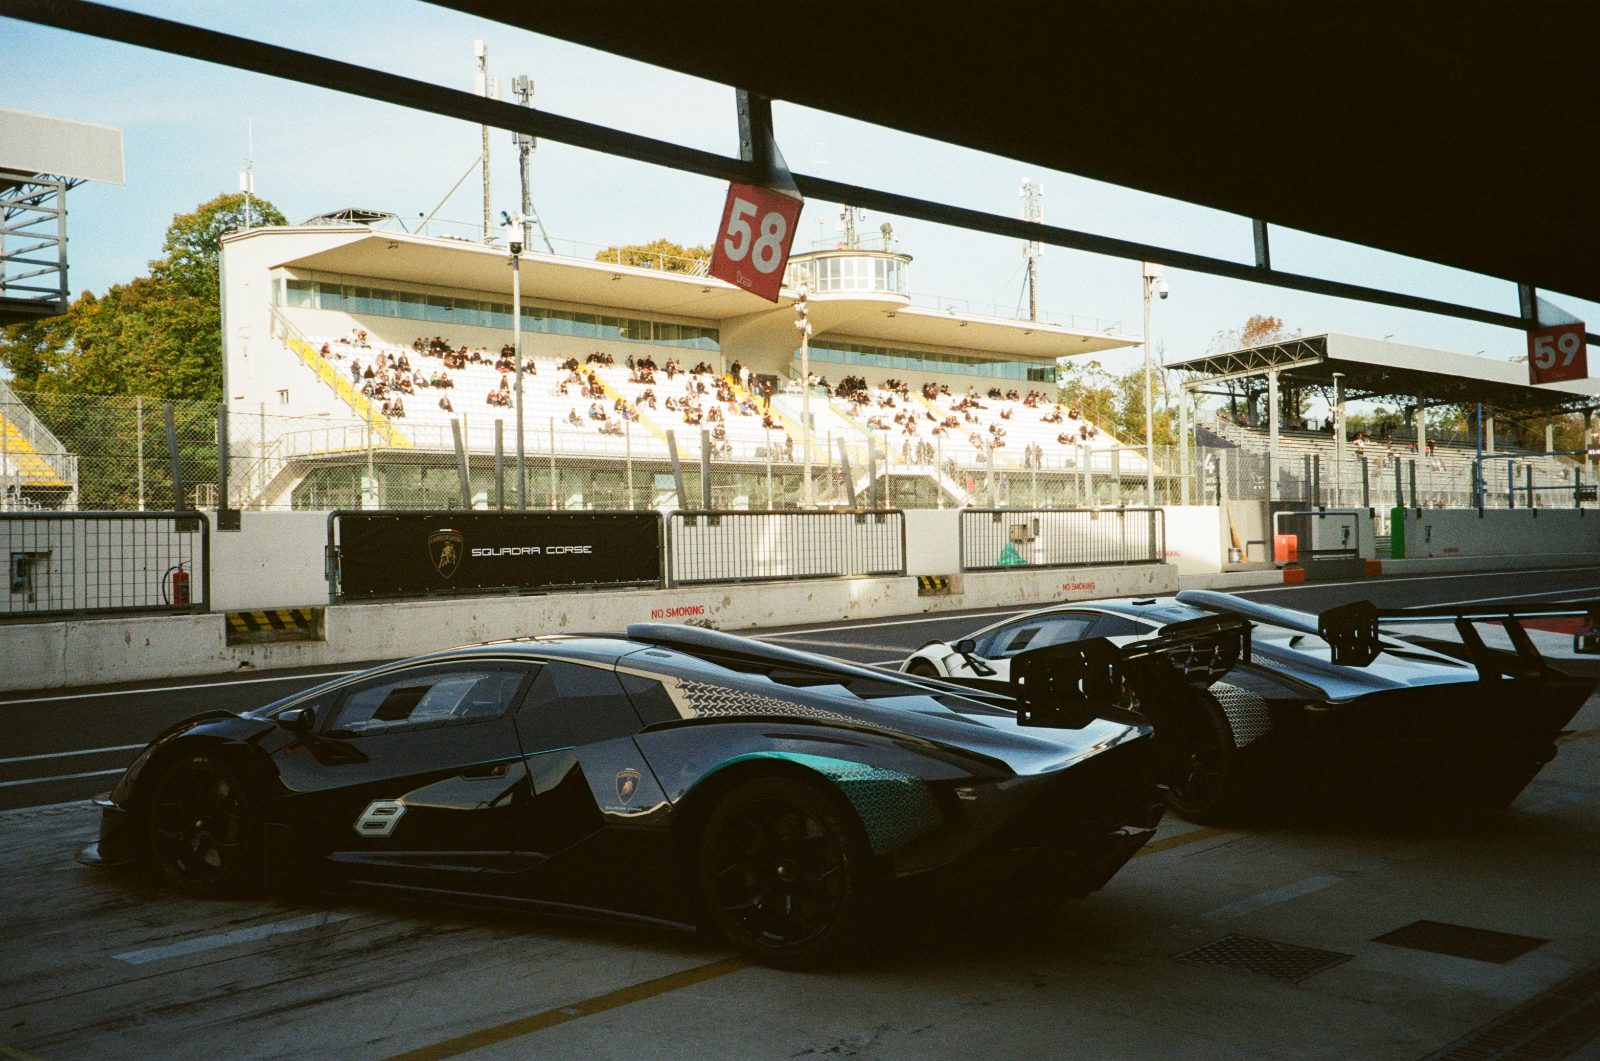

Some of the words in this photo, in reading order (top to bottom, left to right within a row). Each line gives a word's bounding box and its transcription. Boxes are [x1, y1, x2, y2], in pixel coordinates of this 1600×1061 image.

[724, 197, 787, 274] 58
[1535, 332, 1580, 369] 59
[471, 547, 541, 557] SQUADRA
[546, 545, 592, 555] CORSE
[1062, 583, 1071, 591] NO
[1071, 581, 1096, 591] SMOKING
[651, 608, 664, 619] NO
[666, 605, 705, 618] SMOKING
[354, 799, 407, 838] 8
